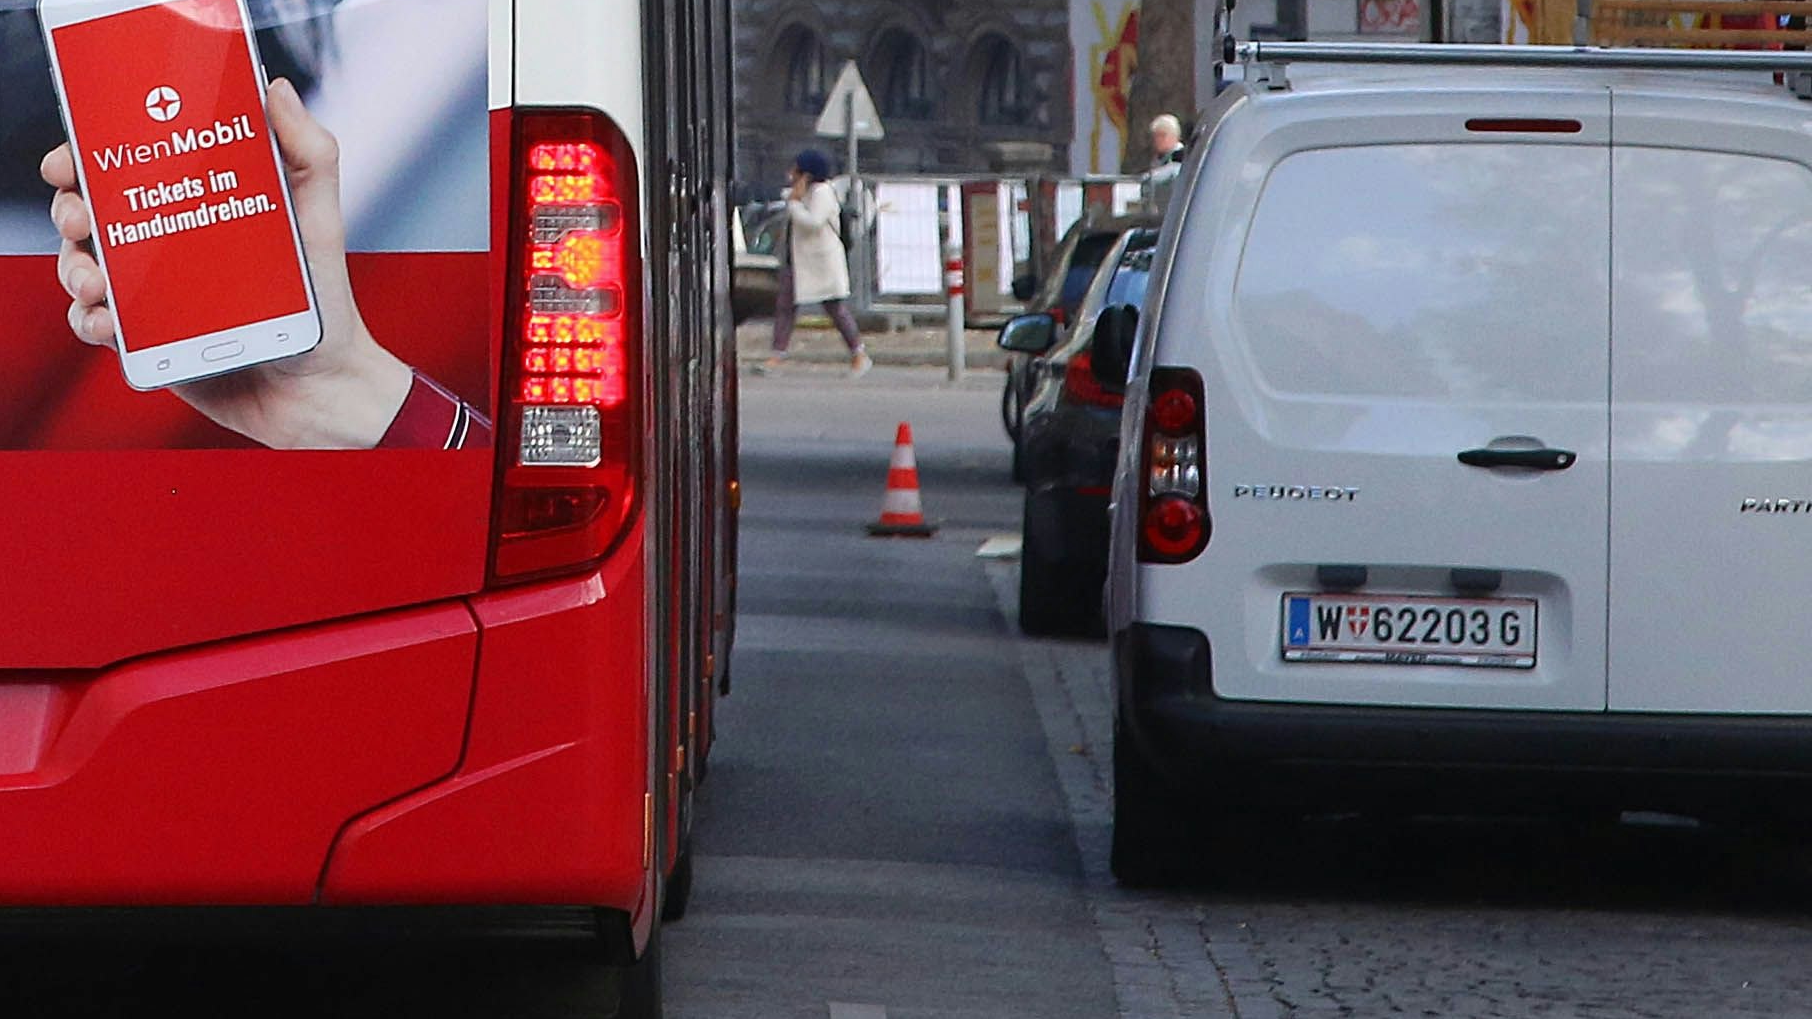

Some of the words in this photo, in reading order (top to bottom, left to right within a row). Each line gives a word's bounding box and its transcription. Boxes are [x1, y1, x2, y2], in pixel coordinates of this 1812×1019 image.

[93, 114, 256, 171] WienMobil
[123, 176, 204, 212] Tickets
[208, 170, 238, 193] im
[106, 193, 278, 247] Handumdrehen.
[1234, 484, 1361, 502] PEUGEOT
[1316, 605, 1343, 641] W
[1373, 607, 1489, 645] 62203
[1499, 610, 1521, 646] G
